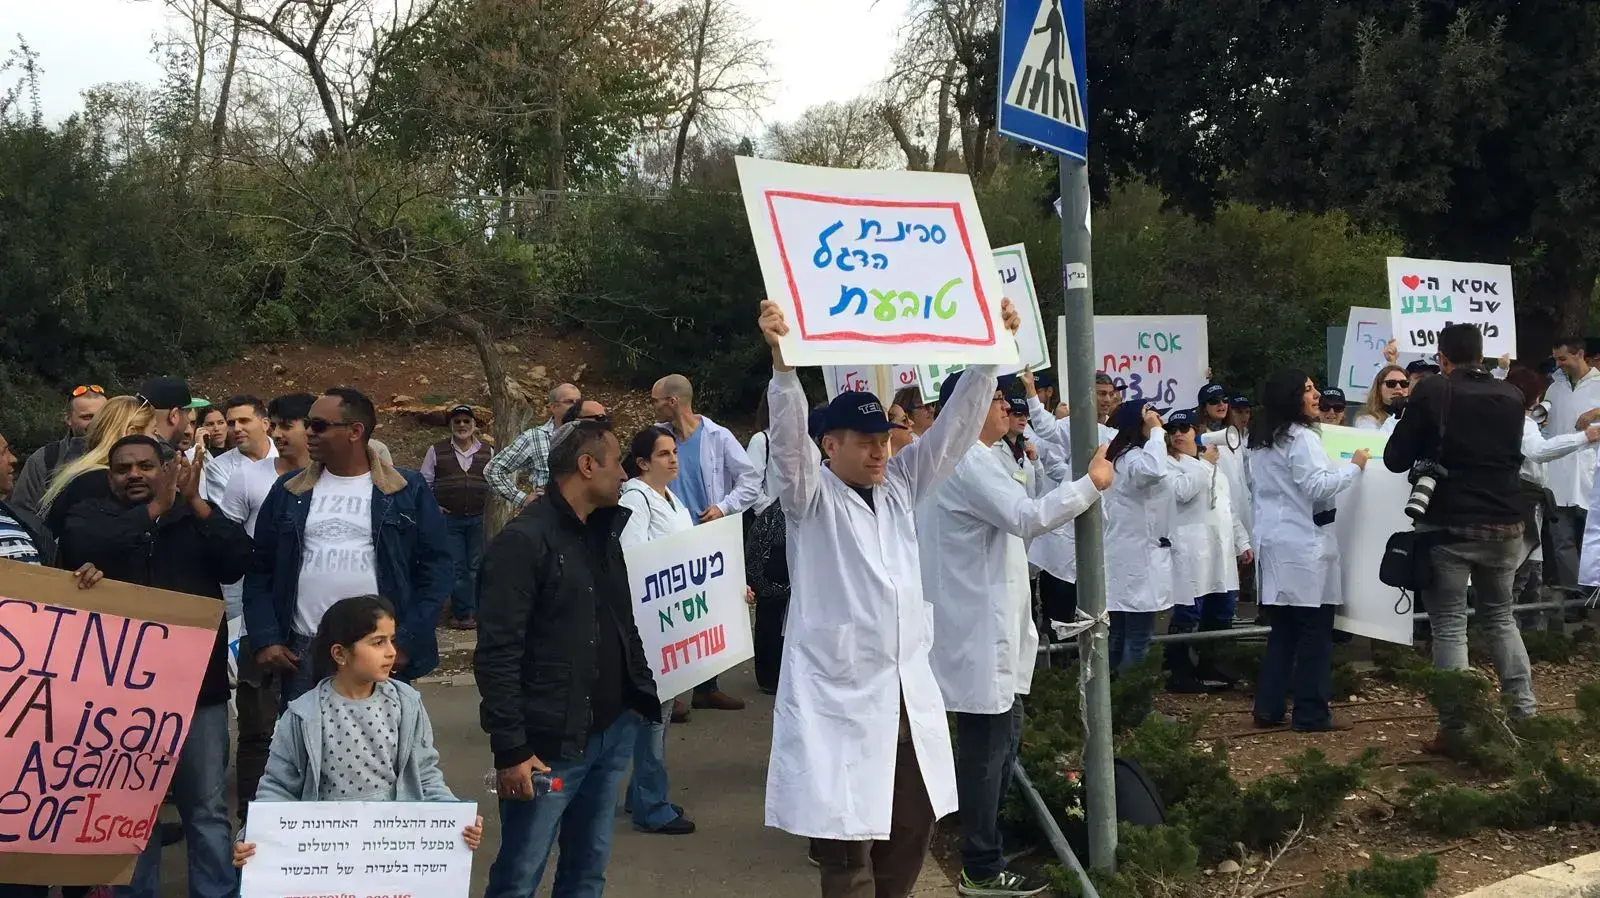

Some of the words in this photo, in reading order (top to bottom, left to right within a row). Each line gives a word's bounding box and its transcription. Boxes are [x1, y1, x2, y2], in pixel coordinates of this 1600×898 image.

[855, 218, 947, 245] ספינת
[813, 220, 889, 272] הדגל
[1452, 278, 1499, 296] אסיא
[829, 277, 964, 322] טובעת
[1469, 297, 1501, 314] של
[1095, 354, 1162, 374] חייבת
[641, 551, 725, 604] משפחת
[661, 624, 726, 676] שורדת
[119, 707, 184, 754] an
[13, 741, 170, 795] Against
[75, 793, 159, 843] Israel
[280, 816, 298, 830] של
[301, 819, 358, 829] האחרונות
[373, 816, 426, 829] ההצלחות
[430, 819, 456, 829] אחת
[297, 838, 350, 853] ירושלים
[361, 836, 416, 851] הטבליות
[420, 837, 455, 851] מפעל
[280, 866, 329, 876] התכשיר
[336, 862, 355, 875] של
[364, 860, 409, 874] בלעדית
[413, 863, 447, 876] השקה
